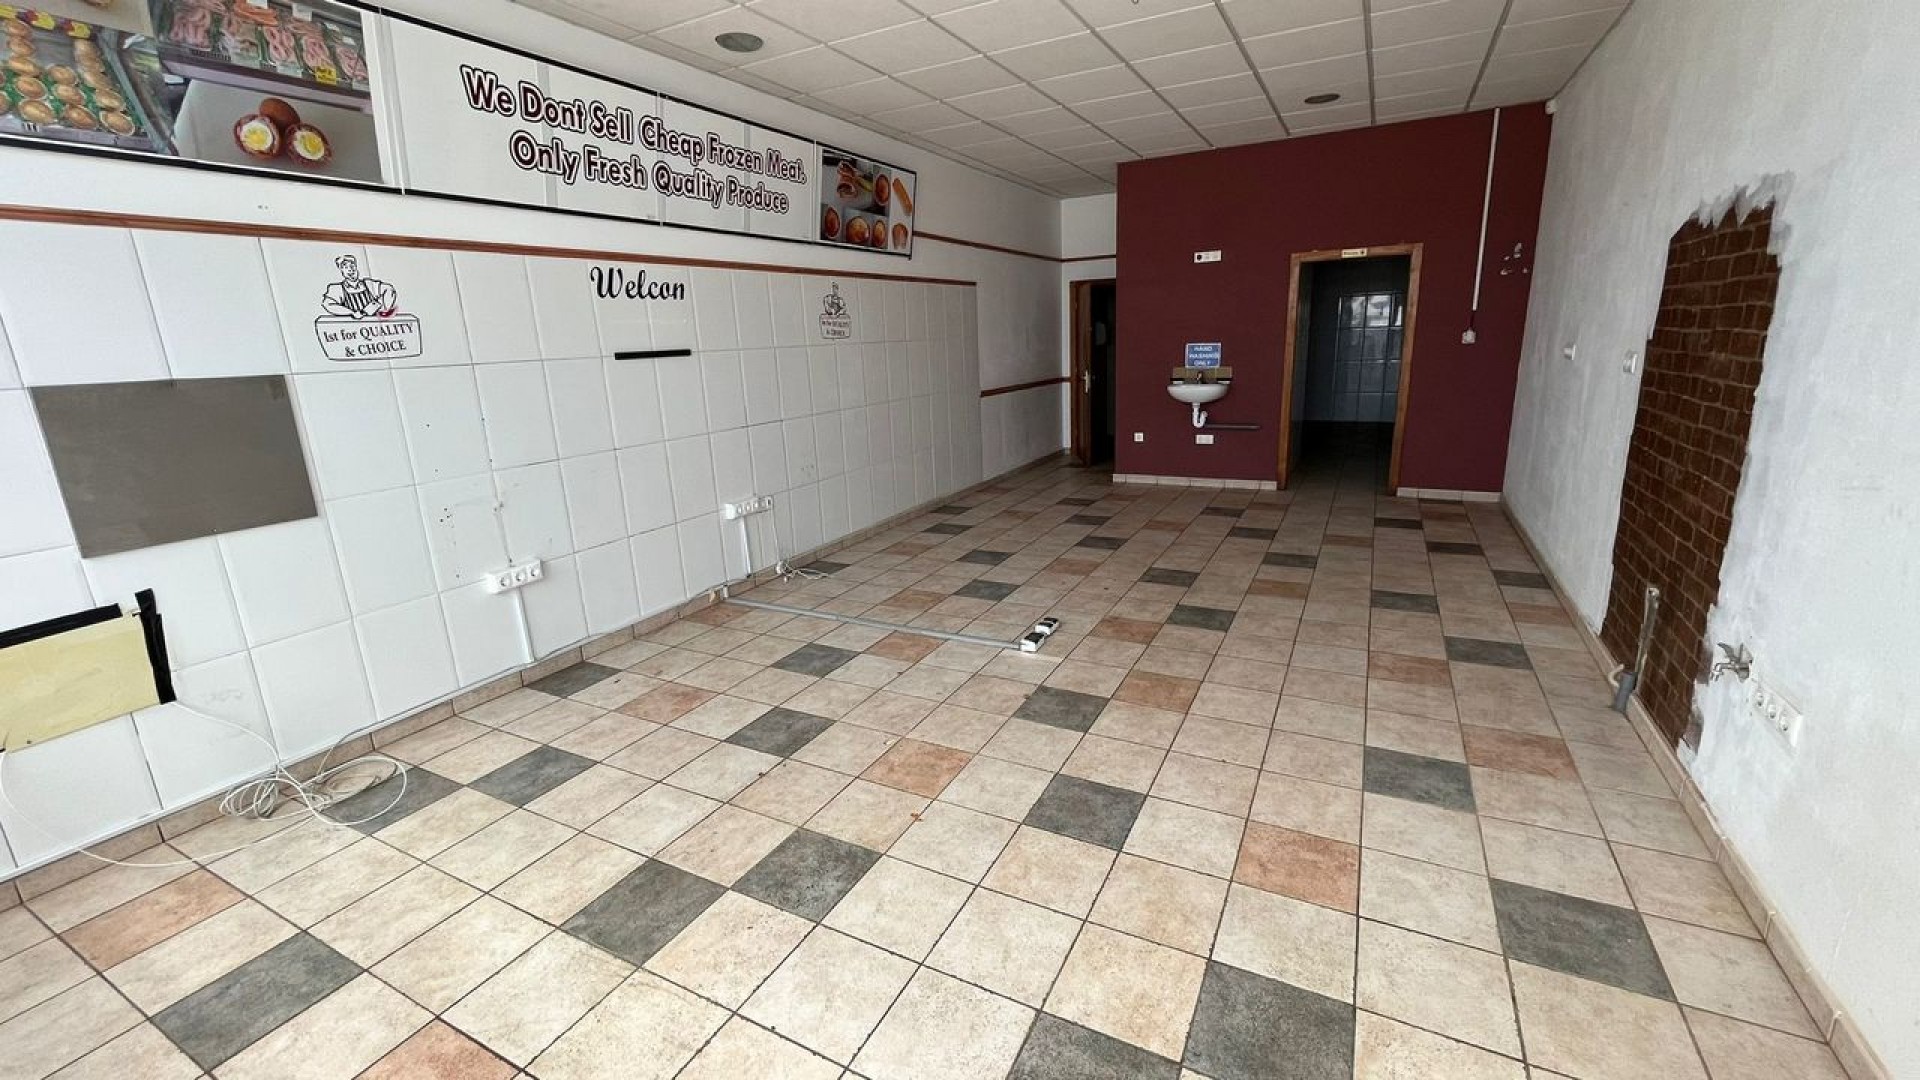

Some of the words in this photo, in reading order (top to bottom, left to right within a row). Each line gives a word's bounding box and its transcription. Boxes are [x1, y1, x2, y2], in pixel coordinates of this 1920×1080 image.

[460, 64, 517, 117] We
[518, 80, 587, 133] Dont
[589, 101, 633, 145] Sell
[639, 115, 705, 167] Cheap
[706, 131, 764, 175] Frozen
[509, 130, 581, 185] Only
[584, 144, 648, 190] Fresh
[653, 160, 725, 209] Quality
[725, 174, 790, 214] Produce
[340, 329, 357, 340] for
[359, 323, 413, 340] QUALITY
[344, 345, 356, 358] &
[358, 340, 407, 356] CHOICE
